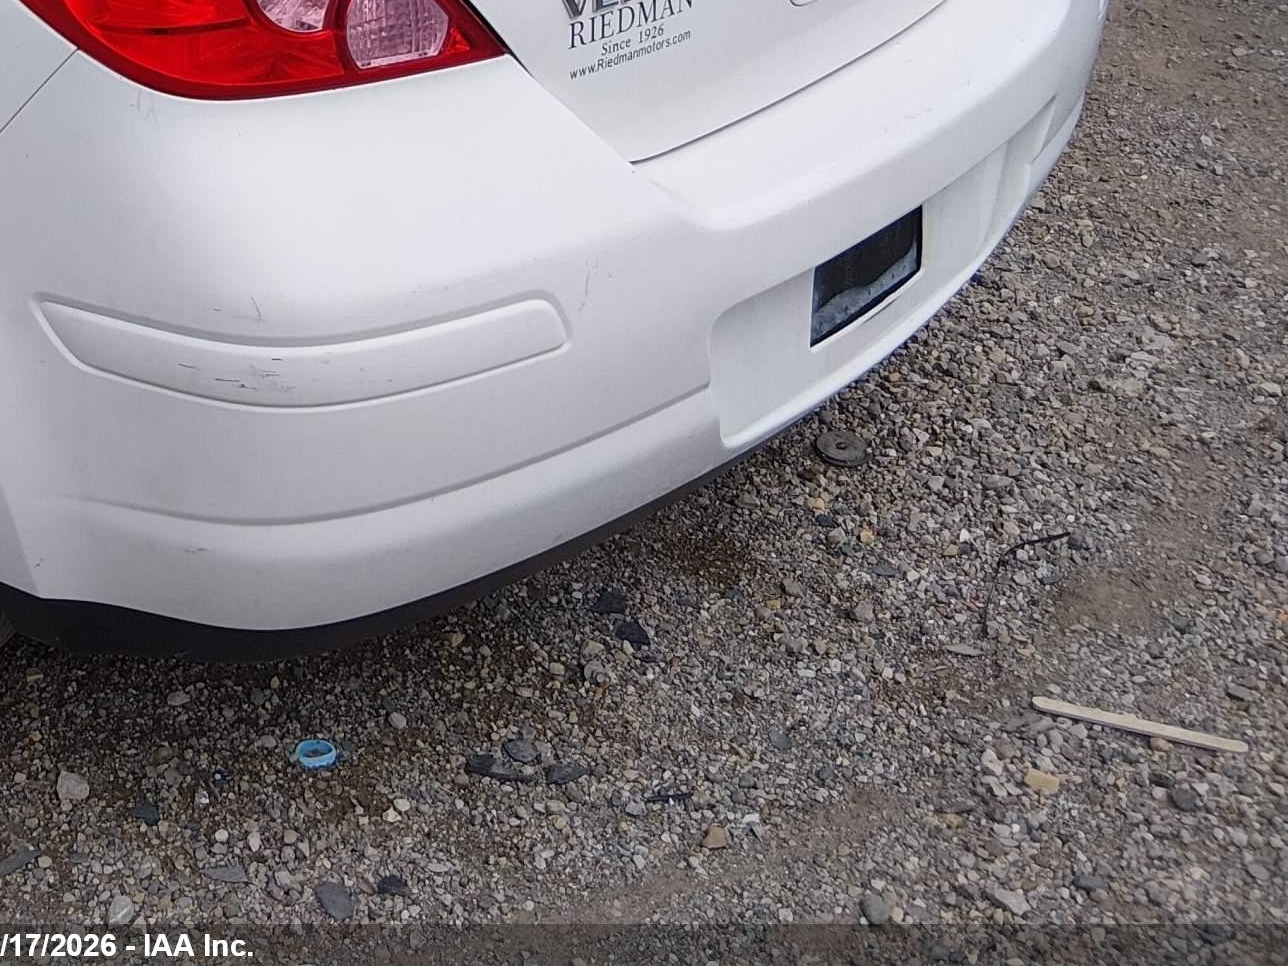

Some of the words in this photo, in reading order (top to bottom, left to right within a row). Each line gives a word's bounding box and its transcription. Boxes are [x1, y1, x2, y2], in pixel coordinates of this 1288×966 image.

[569, 29, 692, 80] www.Riedmanmotors.com
[601, 38, 632, 56] Since
[638, 24, 665, 44] 1926
